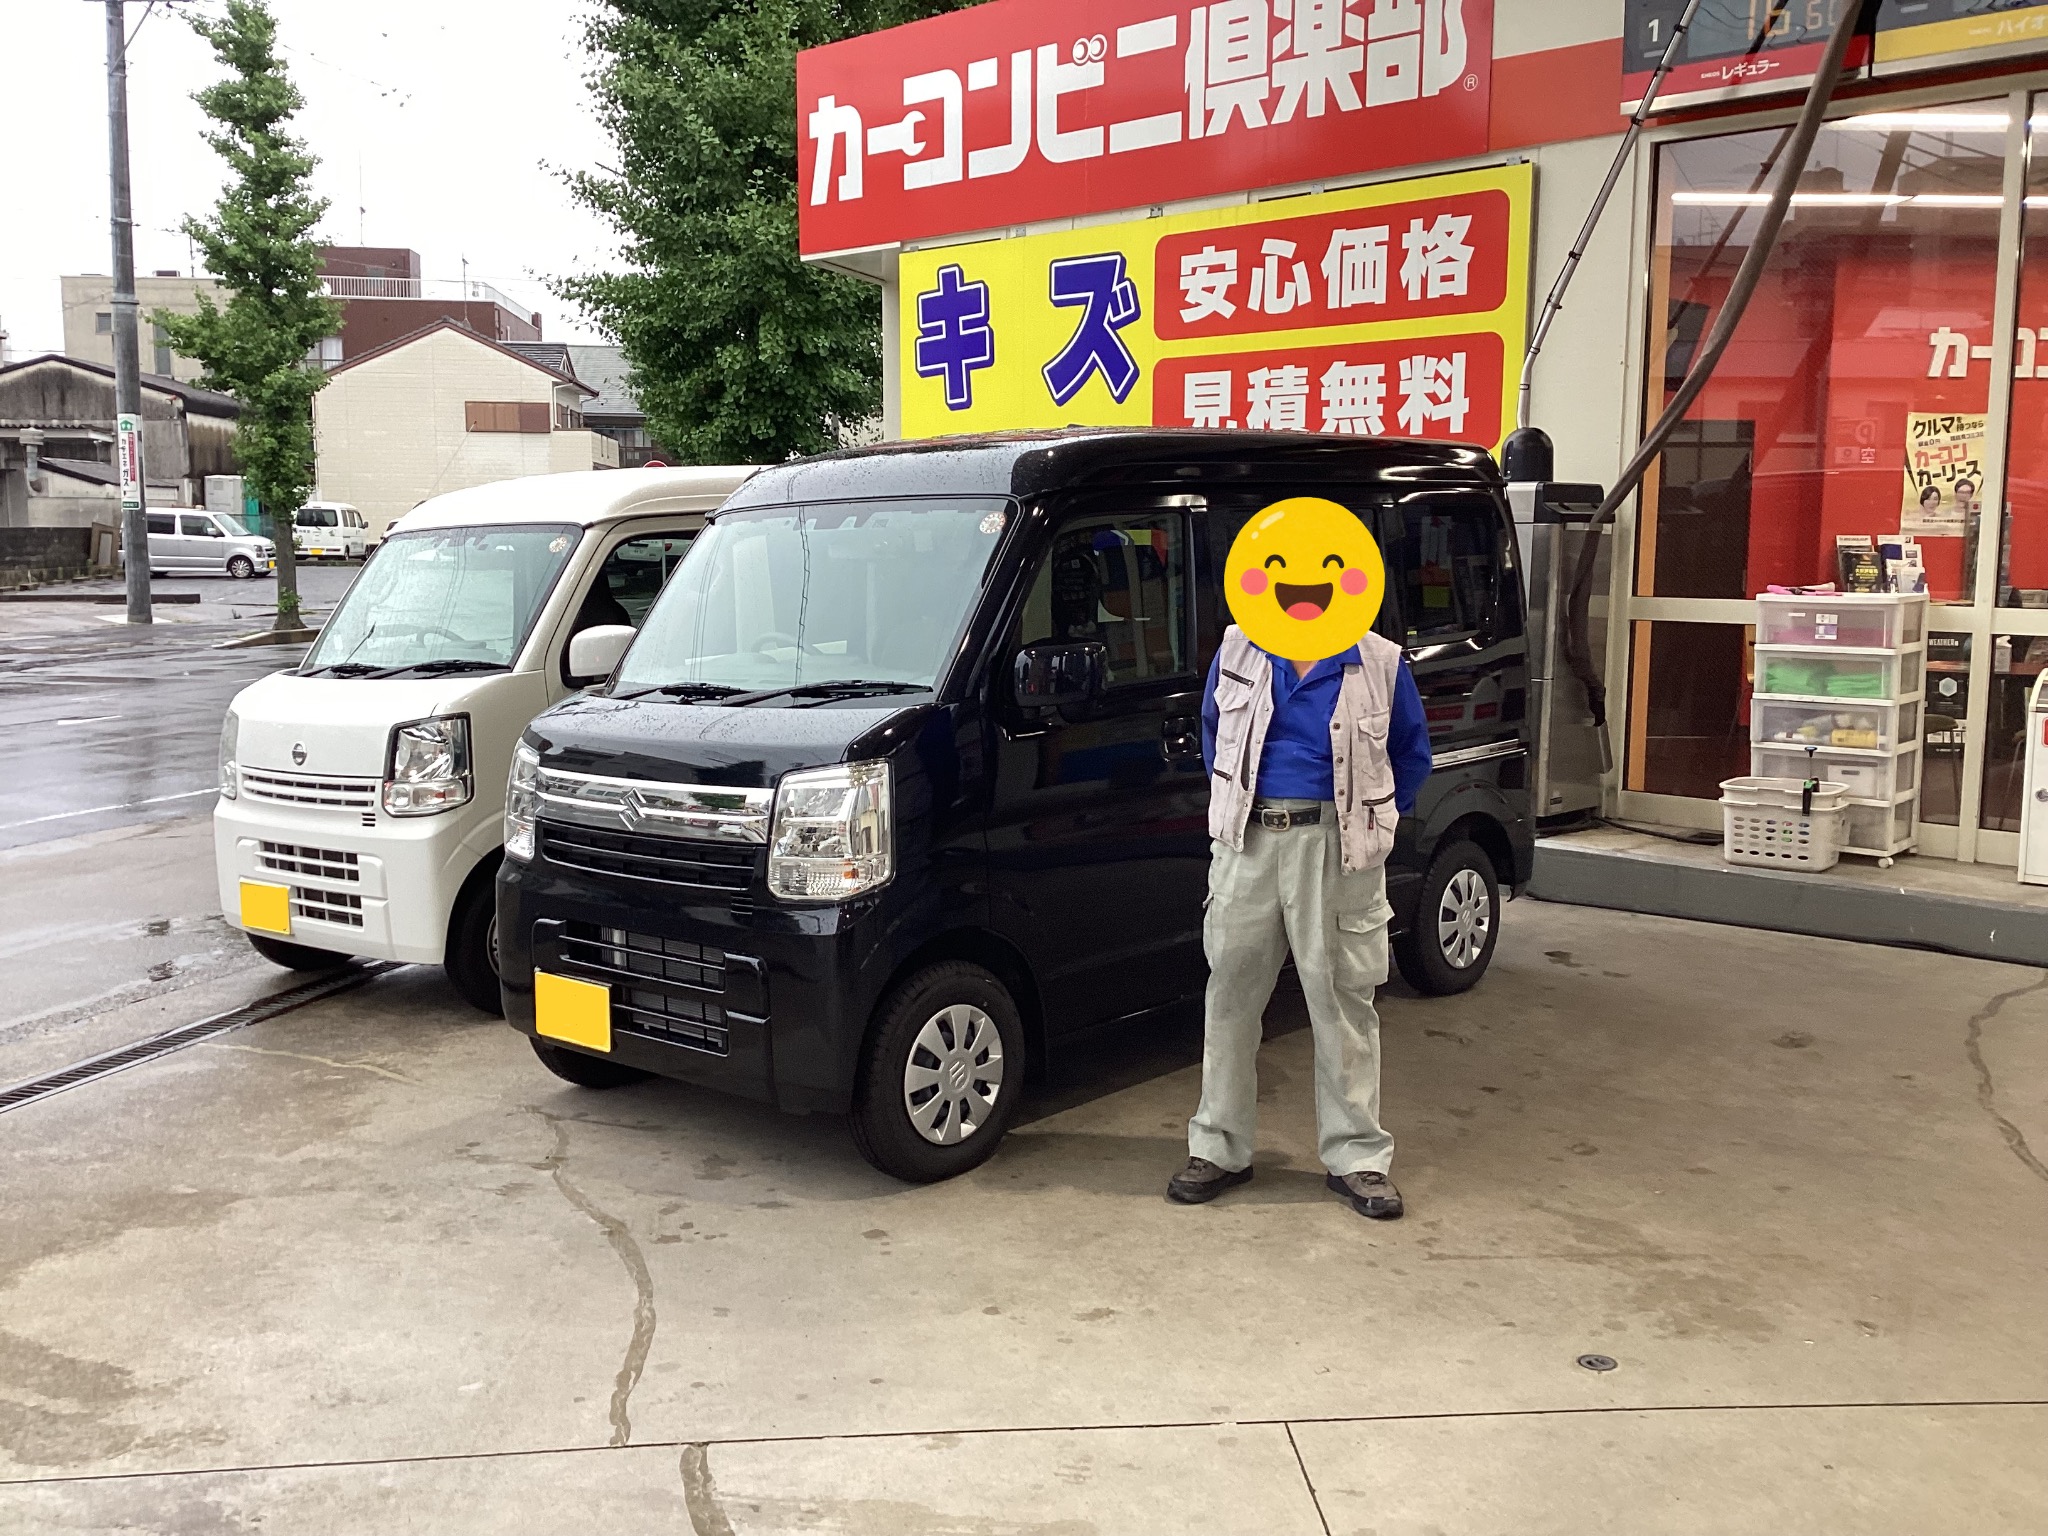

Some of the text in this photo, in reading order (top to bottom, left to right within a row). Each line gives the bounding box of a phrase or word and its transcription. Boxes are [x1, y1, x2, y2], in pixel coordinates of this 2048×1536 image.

[1647, 17, 1659, 42] 1
[1722, 59, 1780, 80] レギュラー
[808, 0, 1467, 206] カーコンビニ倶楽部
[1179, 213, 1475, 323] 安心価格
[1183, 353, 1471, 434] 見積無料
[1914, 443, 1968, 469] カーコン
[1916, 460, 1982, 487] カーリース
